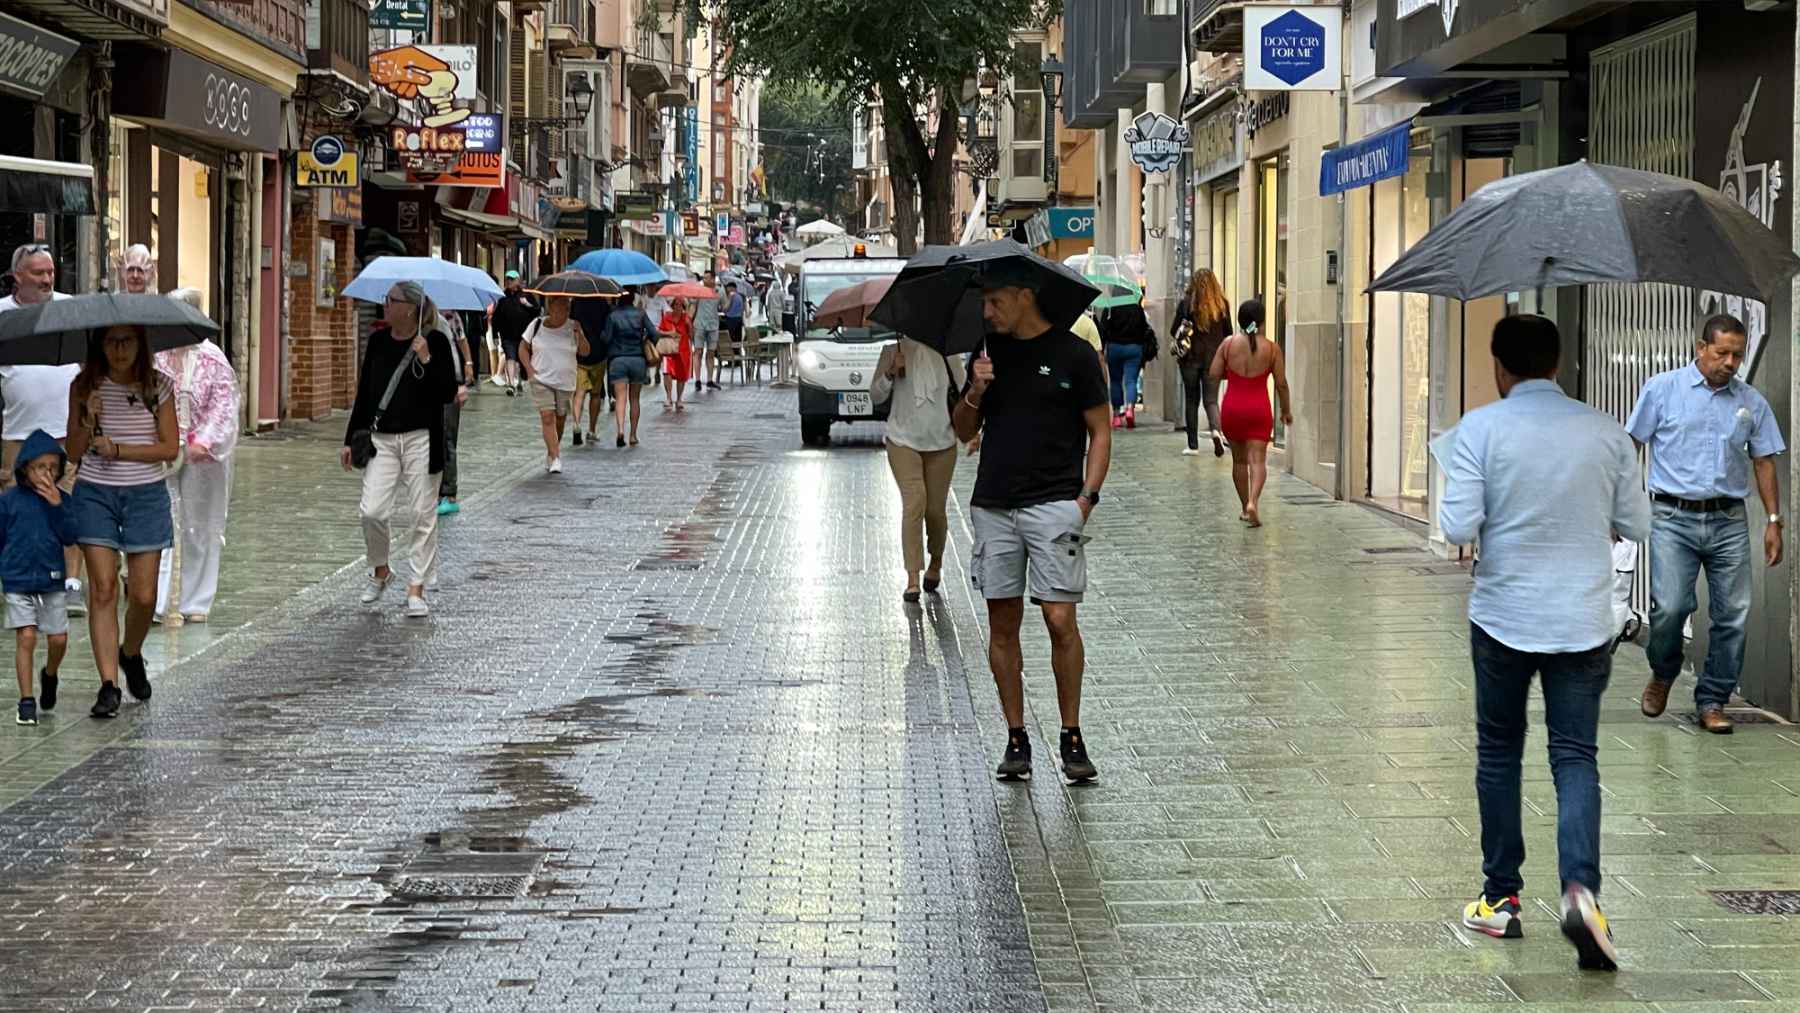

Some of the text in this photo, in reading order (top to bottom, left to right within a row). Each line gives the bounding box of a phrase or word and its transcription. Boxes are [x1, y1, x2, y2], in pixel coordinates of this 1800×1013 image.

[386, 0, 409, 10] Dental
[1264, 36, 1320, 47] DON'T CRY
[1271, 47, 1314, 58] FOR ME
[1133, 138, 1180, 154] MOBILE REPAIR
[307, 169, 348, 185] ATM
